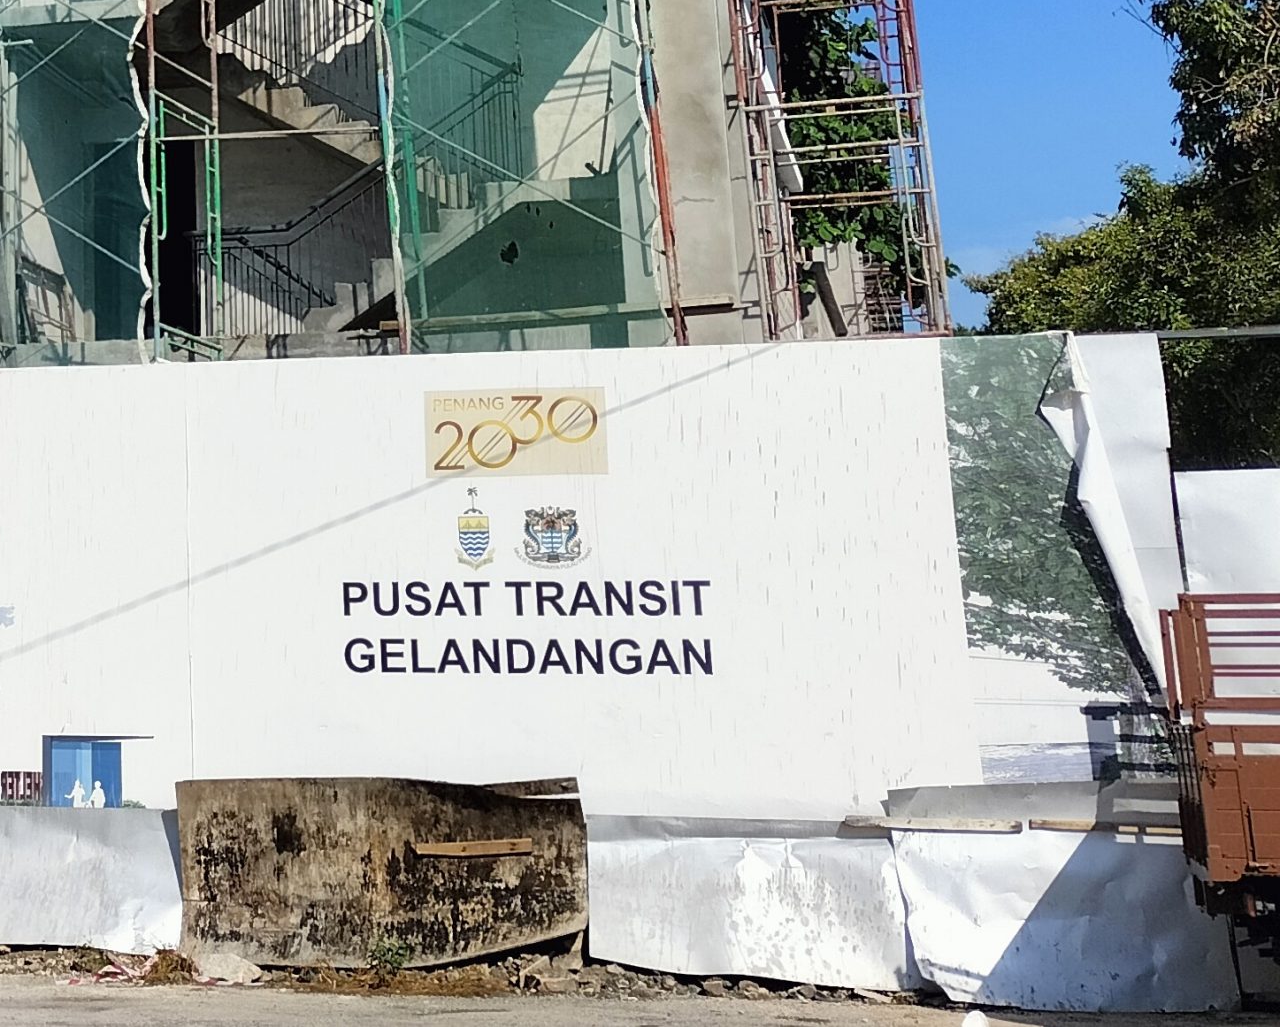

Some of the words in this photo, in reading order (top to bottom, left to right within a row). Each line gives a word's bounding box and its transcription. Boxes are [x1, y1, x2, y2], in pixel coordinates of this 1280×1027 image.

[432, 396, 505, 413] PENANG
[433, 395, 598, 471] 2030
[342, 581, 490, 617] PUSAT
[504, 580, 711, 616] TRANSIT
[344, 637, 714, 675] GELANDANGAN
